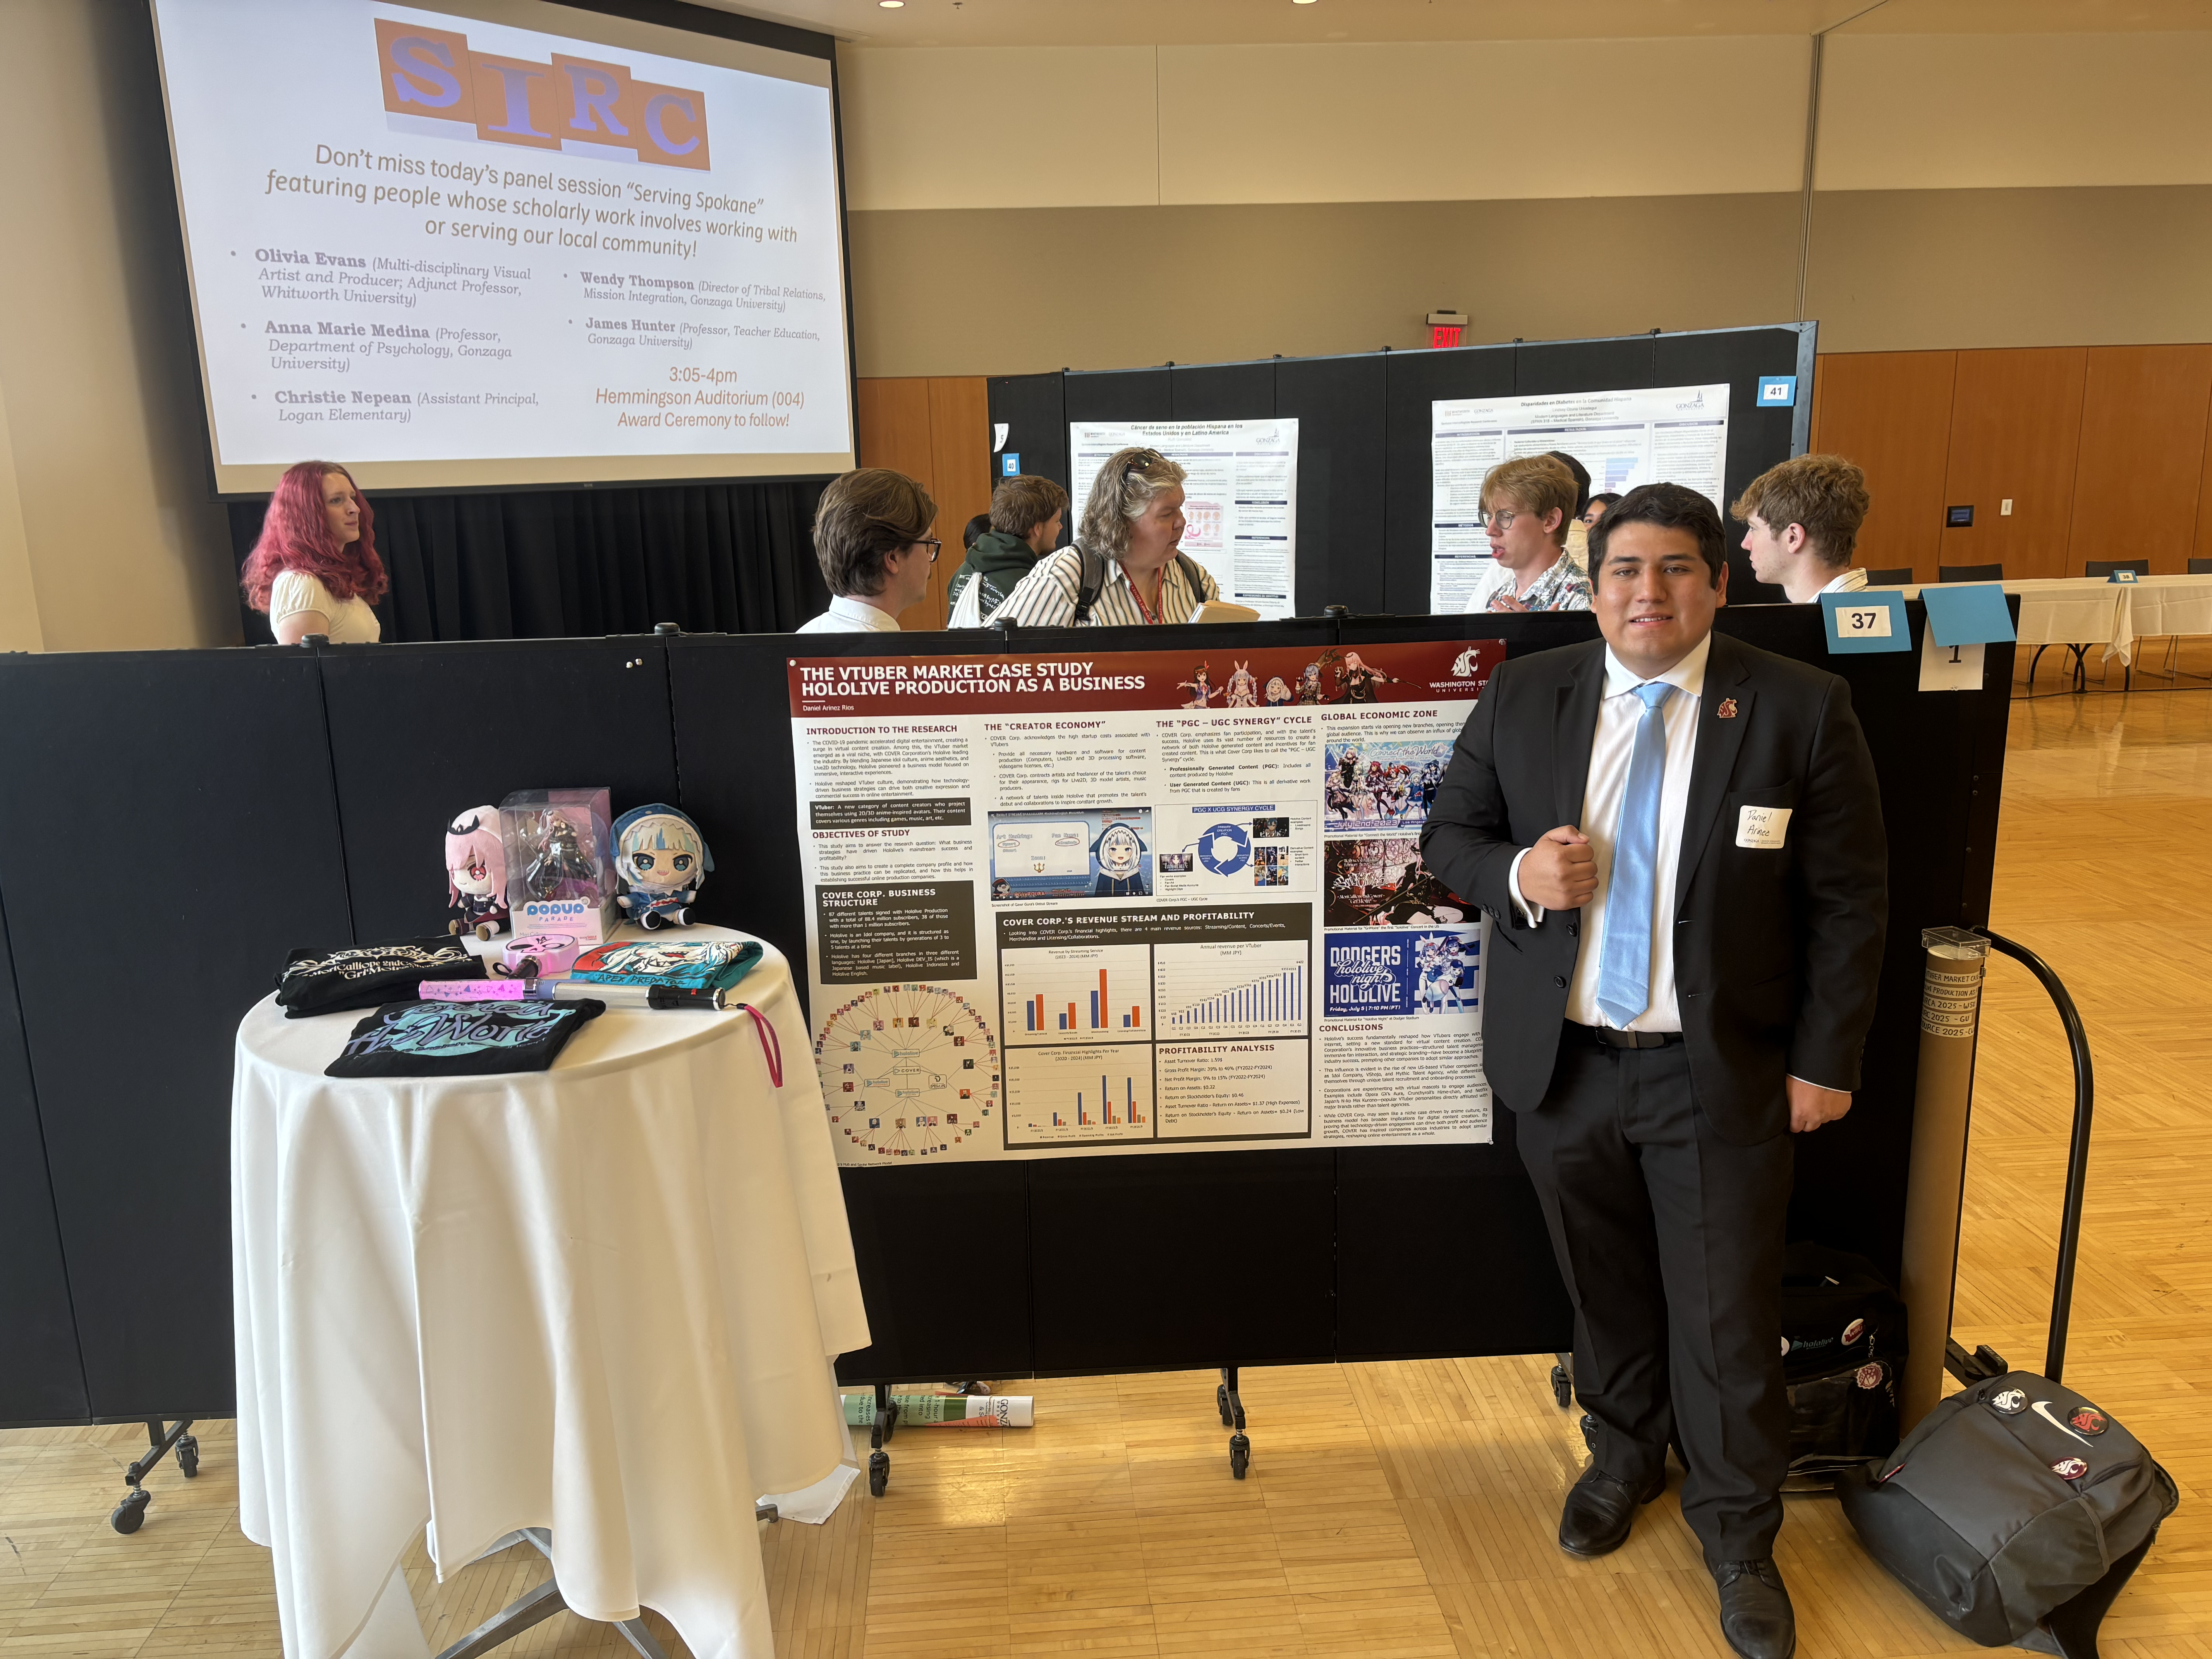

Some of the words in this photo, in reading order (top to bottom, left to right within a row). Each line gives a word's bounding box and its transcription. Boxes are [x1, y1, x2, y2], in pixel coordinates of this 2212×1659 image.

[391, 37, 700, 155] SIRC
[378, 153, 425, 175] miss
[503, 171, 553, 190] panel
[558, 178, 621, 199] session
[264, 169, 366, 203] featuring
[374, 185, 441, 208] people
[447, 190, 507, 213] whose
[512, 197, 590, 225] scholarly
[595, 208, 635, 226] work
[640, 210, 701, 232] involves
[706, 220, 763, 243] working
[768, 226, 797, 243] with
[425, 220, 446, 235] or
[451, 222, 517, 246] serving
[524, 229, 554, 244] our
[559, 227, 597, 249] local
[603, 237, 696, 260] community!
[255, 248, 310, 264] Olivia
[314, 252, 366, 268] Evans
[373, 257, 489, 280] (Multi-disciplinary
[493, 266, 531, 280] Visual
[258, 267, 301, 282] Artist
[305, 270, 334, 283] and
[338, 271, 402, 290] Producer;
[407, 276, 457, 292] Adjunct
[462, 280, 521, 297] Professor,
[261, 285, 340, 301] Whitworth
[344, 289, 416, 308] University)
[1433, 327, 1462, 349] EXIT
[669, 366, 737, 386] 3:05-4pm
[596, 388, 691, 408] Hemmingson
[694, 390, 768, 405] Auditorium
[772, 391, 804, 410] (004)
[1771, 387, 1781, 395] 41
[617, 412, 661, 427] Award
[665, 412, 732, 430] Ceremony
[734, 414, 746, 427] to
[749, 412, 789, 427] follow!
[1851, 613, 1876, 629] 37
[1949, 646, 1961, 663] 1
[800, 667, 835, 681] THE
[838, 666, 908, 680] VTUBER
[913, 664, 984, 679] MARKET
[988, 663, 1032, 678] CASE
[1037, 662, 1093, 677] STUDY
[802, 681, 890, 696] HOLOLIVE
[895, 679, 1010, 694] PRODUCTION
[1016, 678, 1038, 692] AS
[1042, 678, 1054, 692] A
[1060, 675, 1145, 691] BUSINESS
[1321, 713, 1357, 721] GLOBAL
[1360, 711, 1410, 720] ECONOMIC
[806, 726, 876, 735] INTRODUCTION
[912, 725, 957, 733] RESEARCH
[1747, 810, 1772, 823] Daniel
[812, 831, 865, 839] OBJECTIVES
[889, 888, 936, 897] BUSINESS
[823, 898, 878, 907] STRUCTURE
[1037, 917, 1073, 925] CORP.'S
[1183, 912, 1254, 921] PROFITABILITY
[1330, 946, 1401, 967] DODGERS
[1336, 960, 1384, 974] hololive
[1351, 969, 1393, 989] night
[1330, 983, 1401, 1004] HOLOLIVE
[1933, 987, 1968, 996] PRODUCTION
[1319, 1024, 1383, 1032] CONCLUSIONS
[1159, 1046, 1228, 1054] PROFITABILITY
[1230, 1044, 1274, 1052] ANALYSIS
